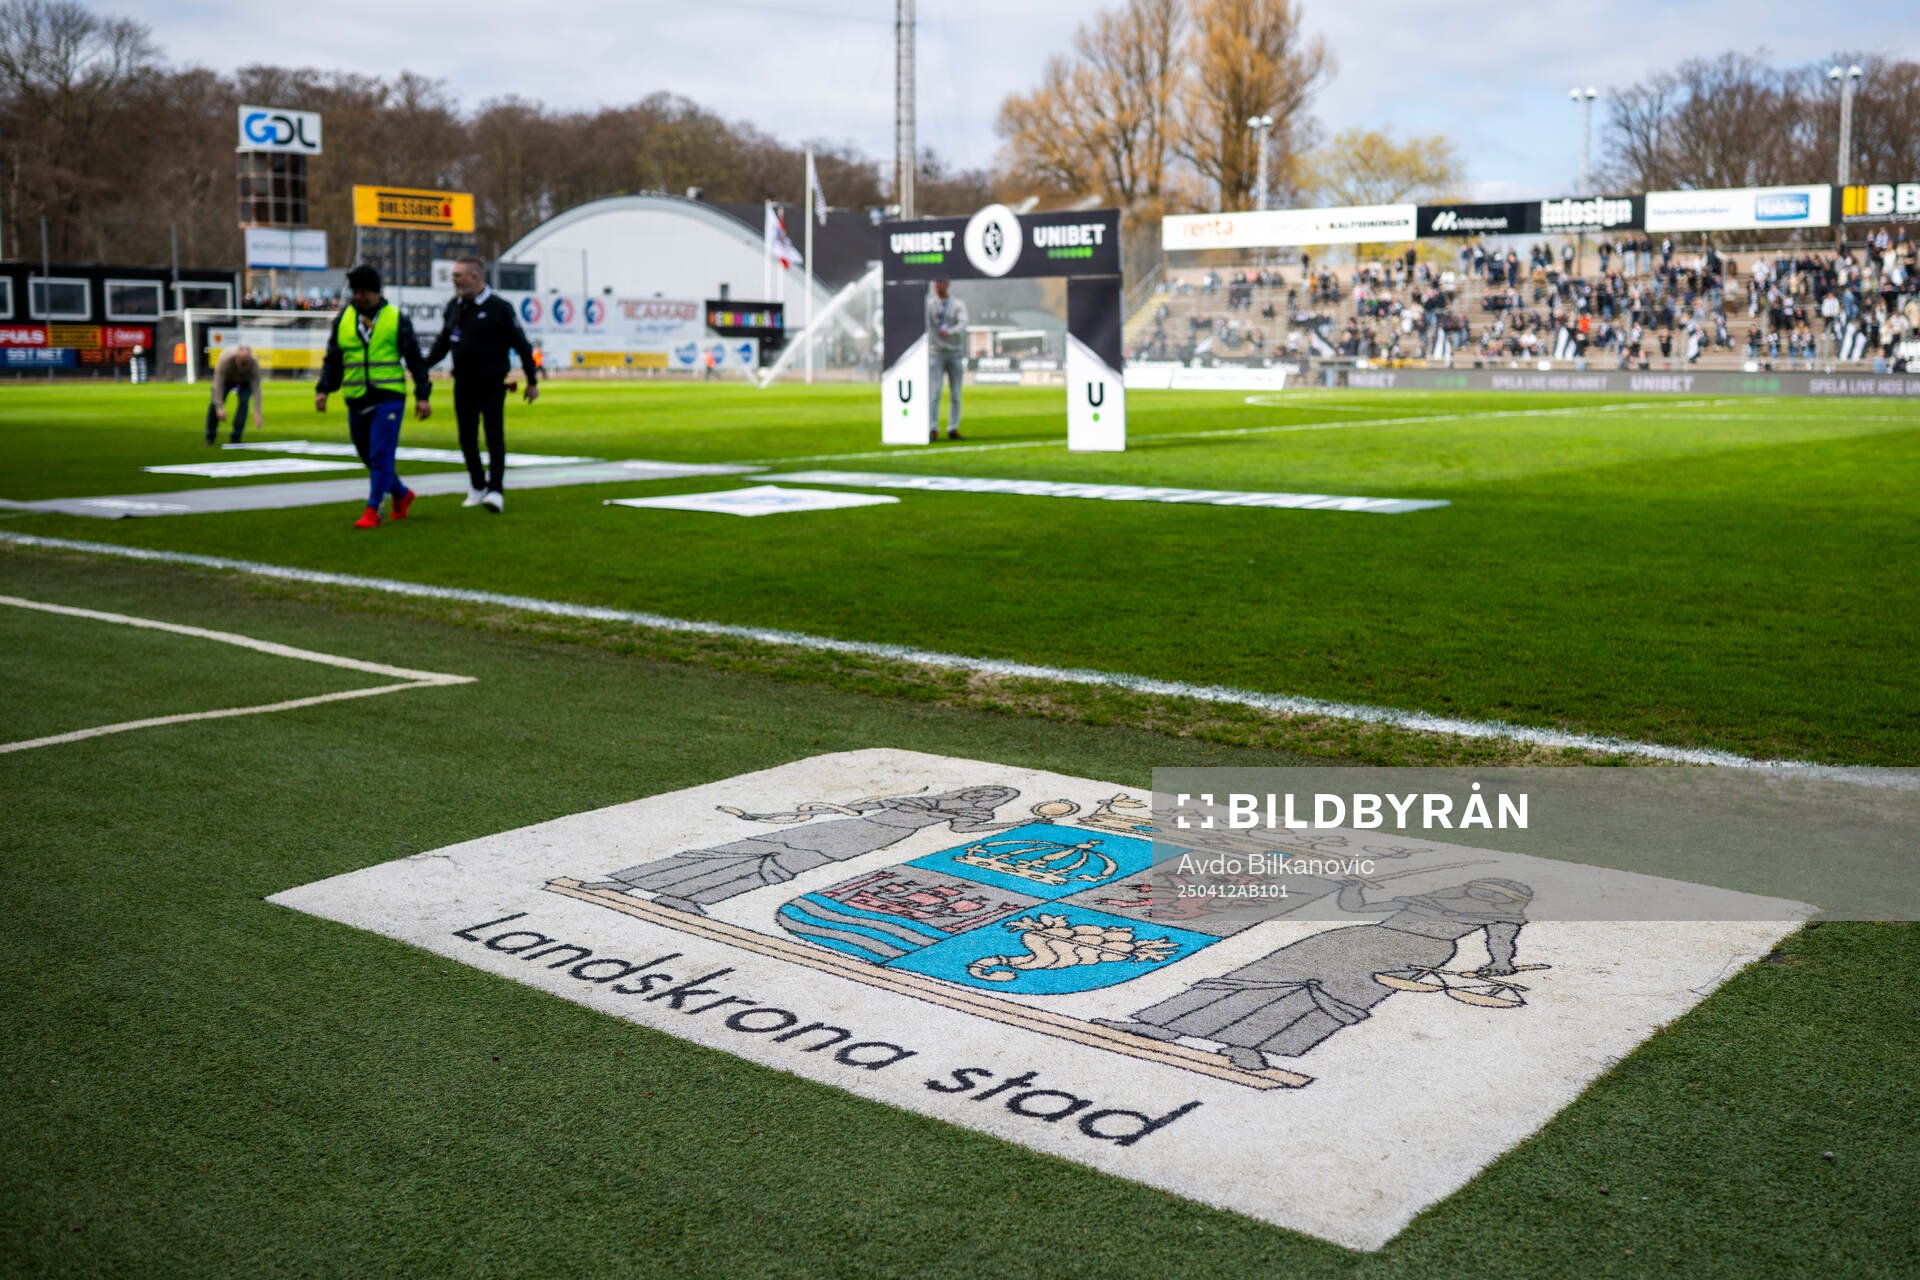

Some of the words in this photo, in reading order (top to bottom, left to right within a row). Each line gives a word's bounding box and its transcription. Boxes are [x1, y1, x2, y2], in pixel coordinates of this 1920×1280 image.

[244, 112, 316, 148] GDL
[1033, 223, 1106, 248] UNIBET
[1183, 220, 1234, 239] renta
[890, 230, 955, 254] UNIBET
[898, 380, 913, 403] U
[1087, 382, 1104, 407] U
[1630, 375, 1693, 392] UNIBET
[1809, 377, 1848, 394] SPELA
[1850, 377, 1876, 394] LIVE
[453, 911, 916, 1071] Landskrona
[925, 1063, 1204, 1147] stad
